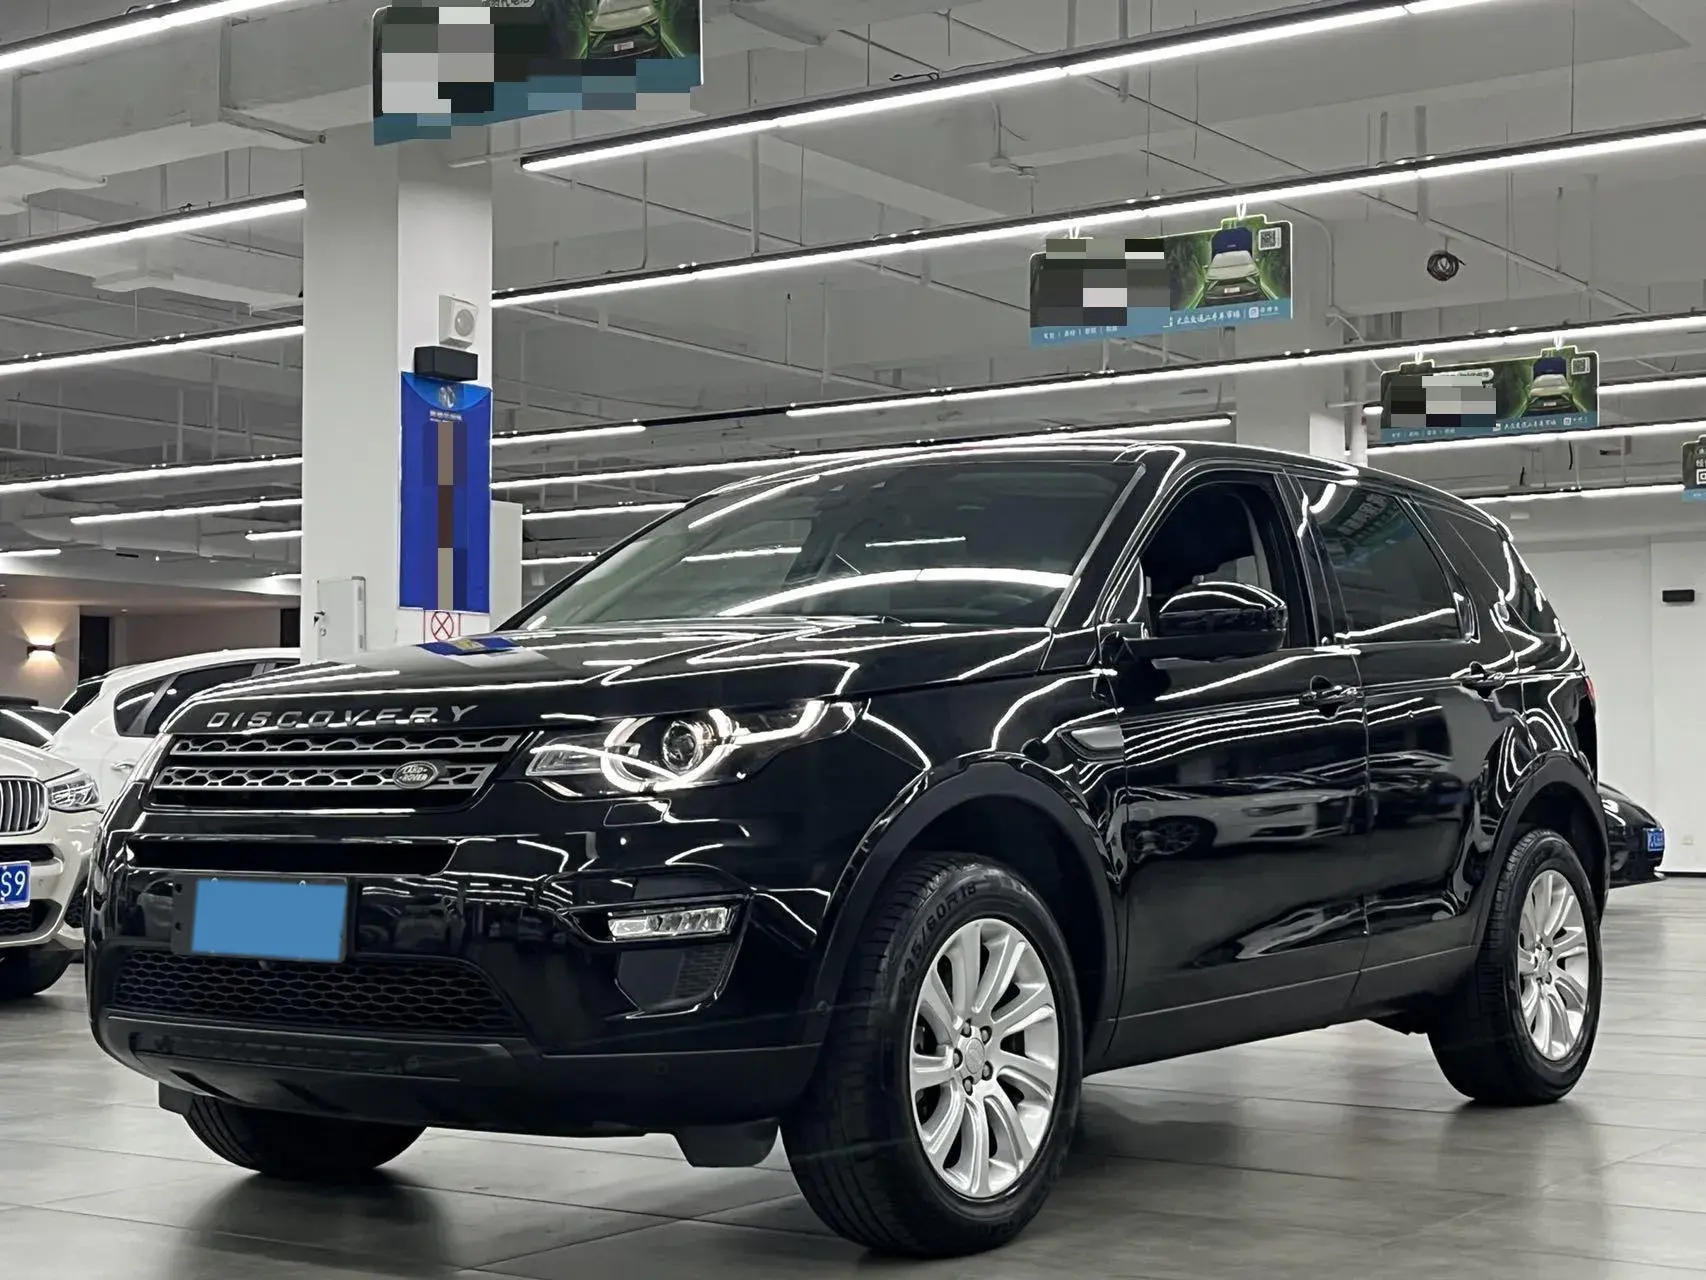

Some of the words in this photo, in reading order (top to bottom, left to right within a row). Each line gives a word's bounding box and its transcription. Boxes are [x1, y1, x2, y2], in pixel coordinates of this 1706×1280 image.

[206, 705, 479, 728] DISCOVERY
[401, 773, 429, 782] ROVER
[1, 870, 26, 897] S9
